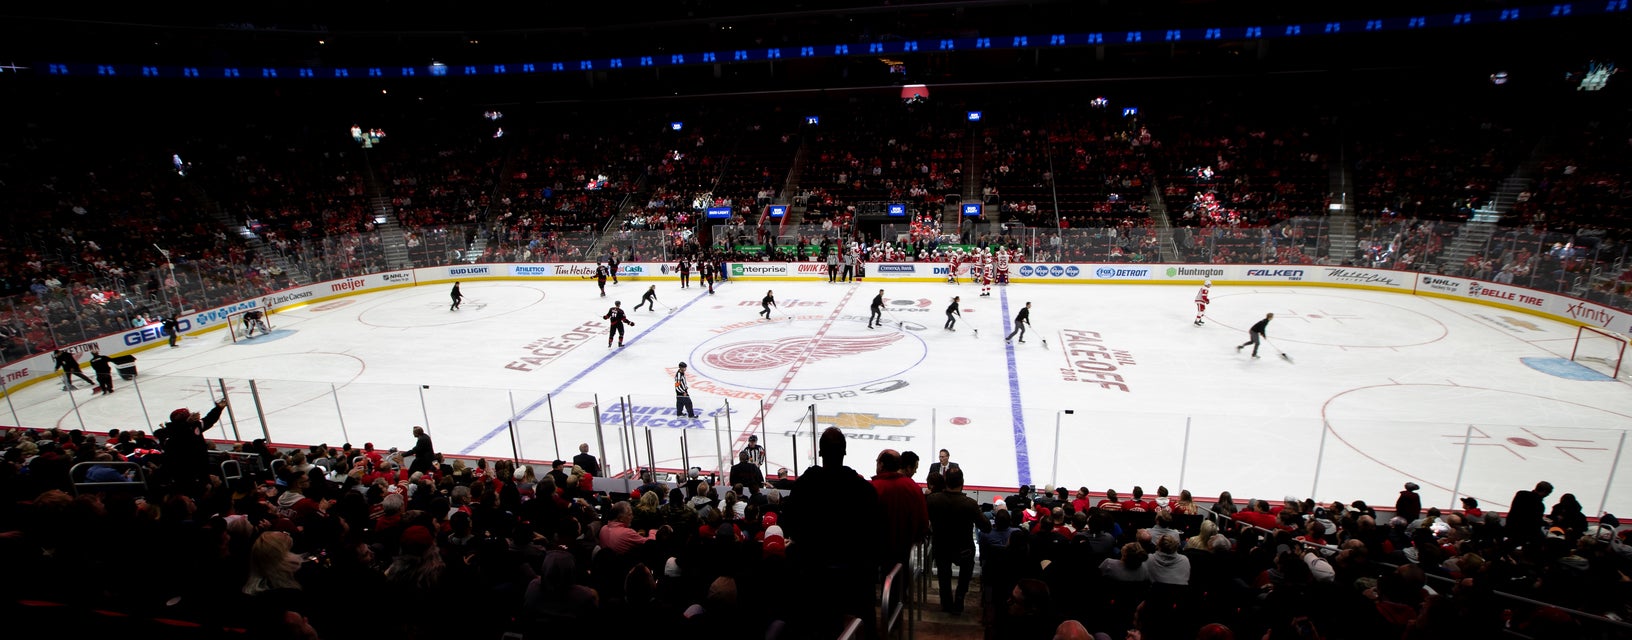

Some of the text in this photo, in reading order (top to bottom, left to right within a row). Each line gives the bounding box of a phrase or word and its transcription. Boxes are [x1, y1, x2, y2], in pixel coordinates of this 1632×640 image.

[554, 265, 569, 275] Tim
[570, 265, 597, 275] Horton
[735, 265, 786, 274] enterprise
[797, 264, 819, 272] QWIK
[1178, 267, 1224, 278] Huntington
[1247, 269, 1304, 277] FALKEN
[331, 278, 366, 293] meijer
[273, 290, 313, 305] Little Caesars
[1480, 288, 1545, 307] BELLE TIRE
[1566, 303, 1614, 327] xfinity
[6, 367, 30, 382] TIRE
[691, 380, 766, 401] Caesars
[784, 388, 858, 402] arena
[600, 412, 711, 429] Wilcox
